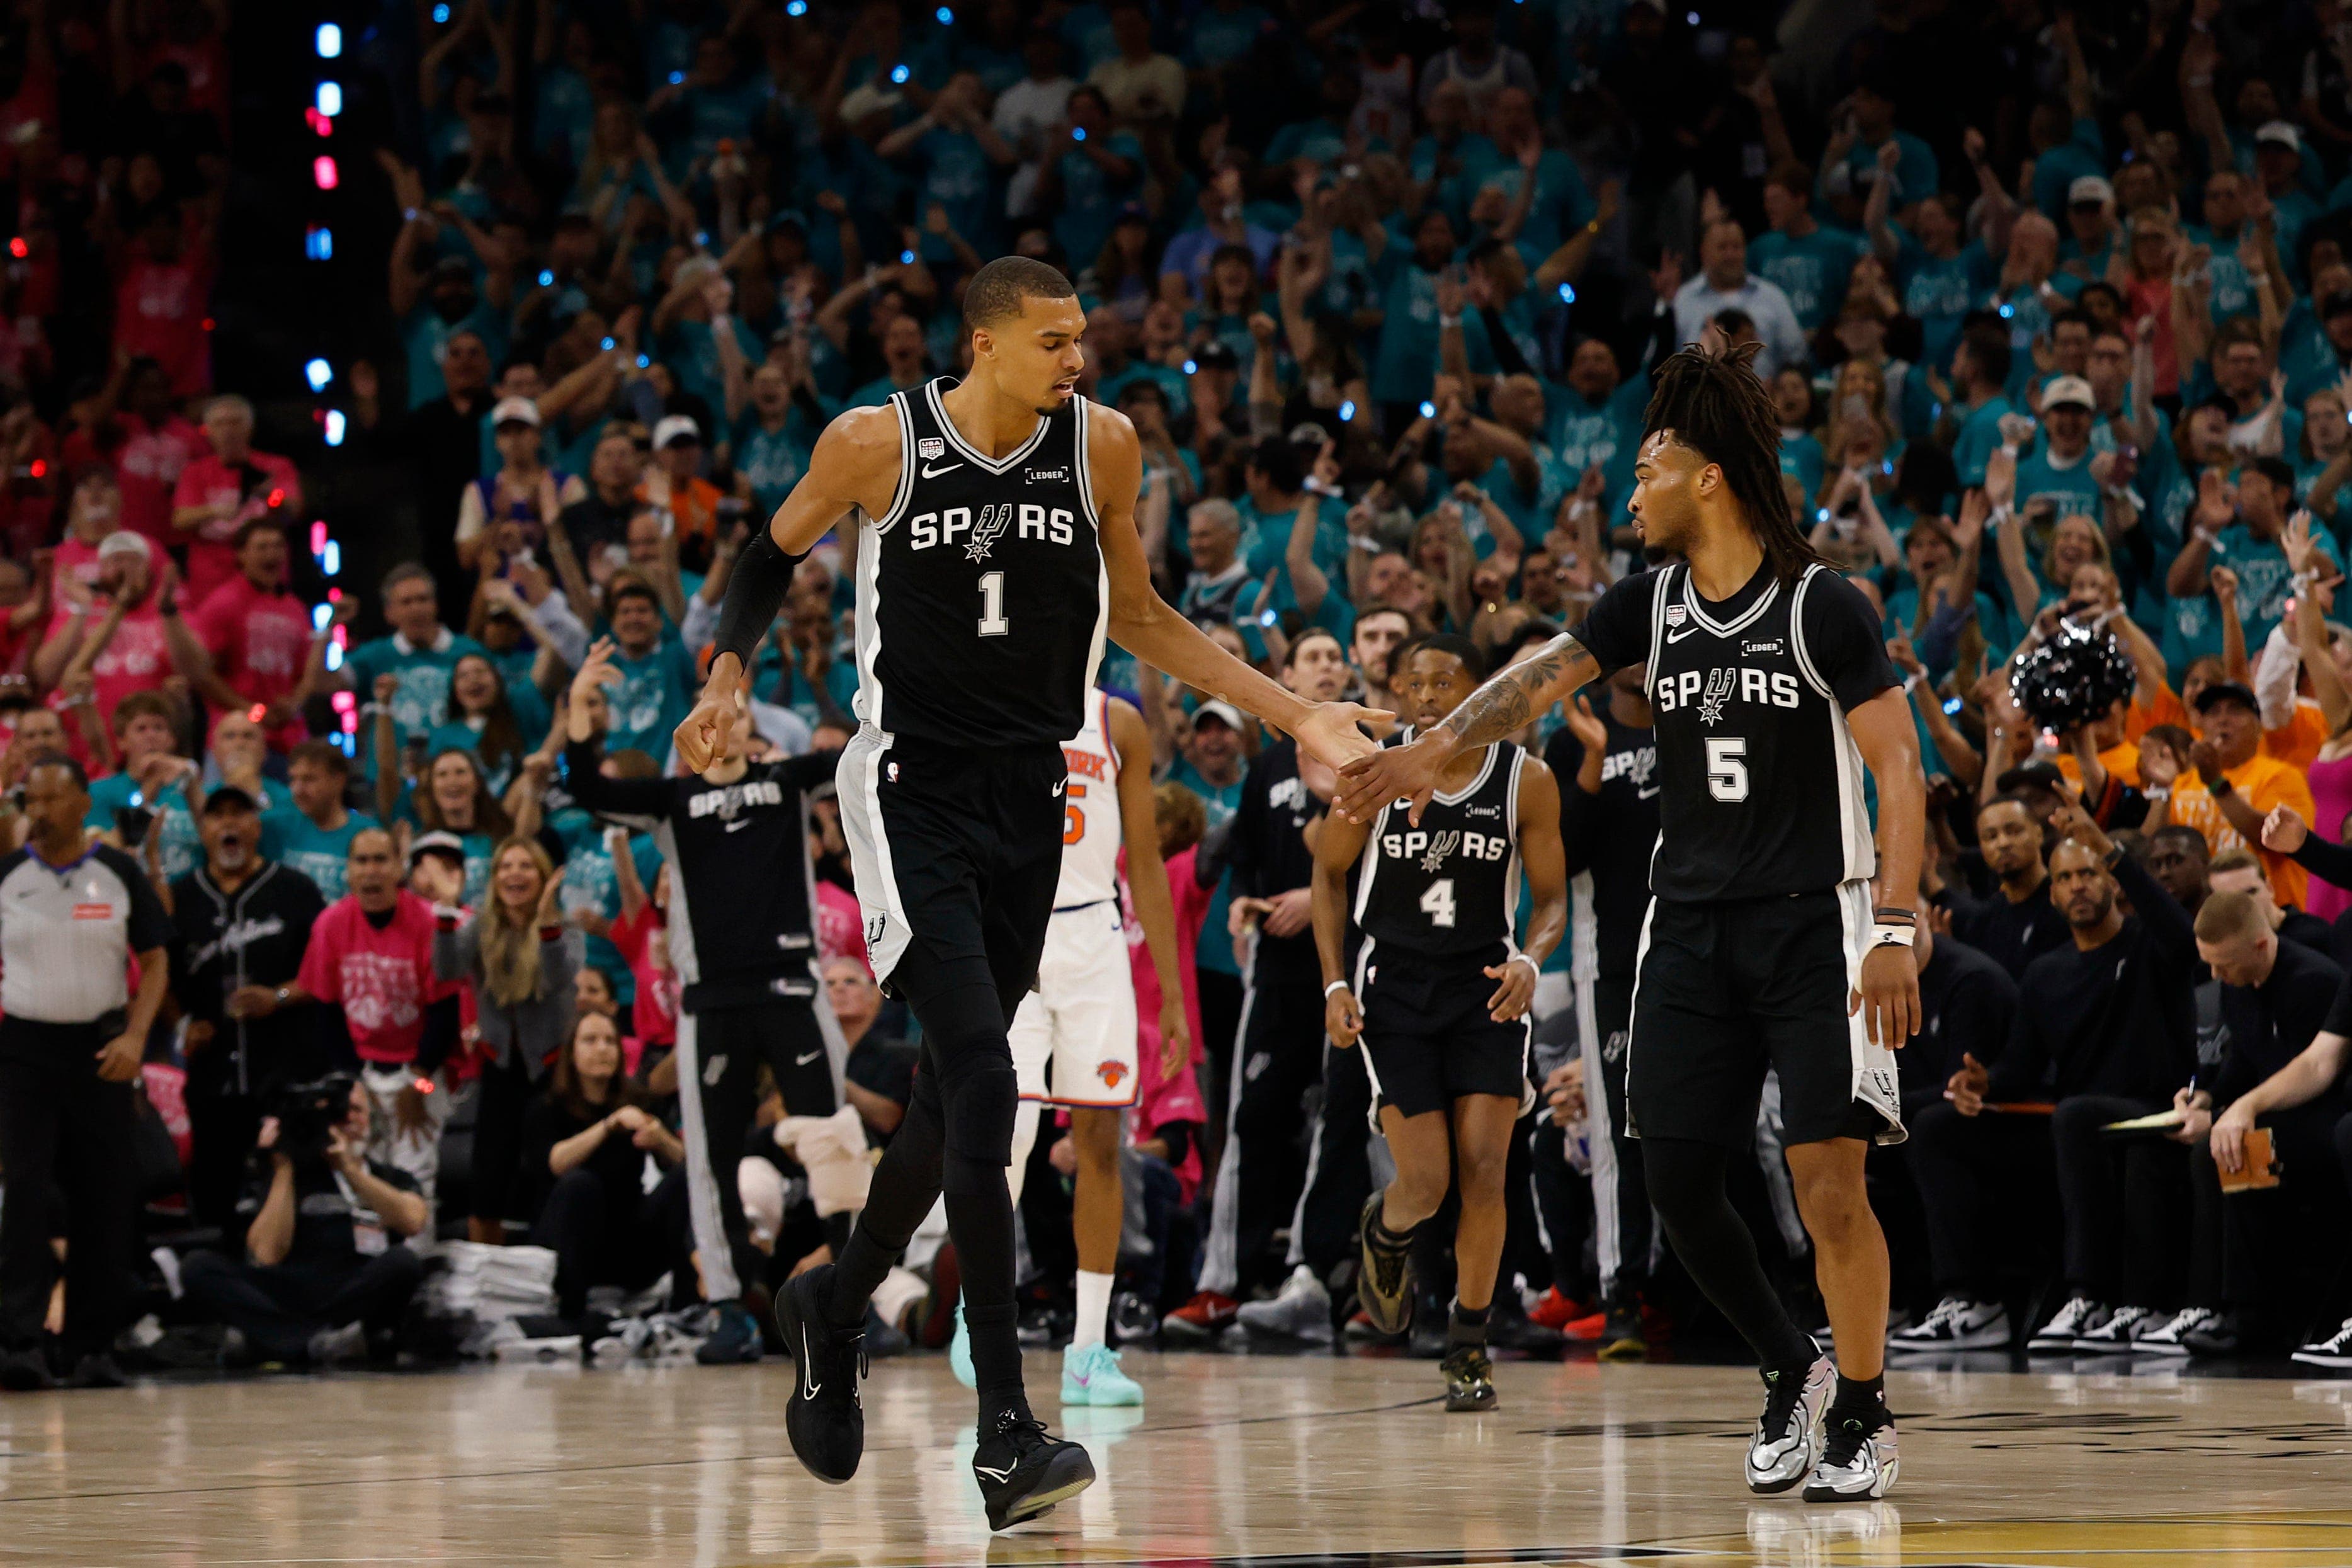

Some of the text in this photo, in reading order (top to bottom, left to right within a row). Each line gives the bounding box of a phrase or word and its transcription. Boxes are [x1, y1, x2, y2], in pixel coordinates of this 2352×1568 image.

[1031, 470, 1063, 480] LEDGER
[911, 503, 1074, 564] SPURS
[978, 571, 1008, 637] 1
[1746, 643, 1778, 652] LEDGER
[1658, 668, 1799, 727] SPURS
[1705, 737, 1749, 802] 5
[1383, 830, 1506, 873] SPURS
[1419, 878, 1457, 928] 4
